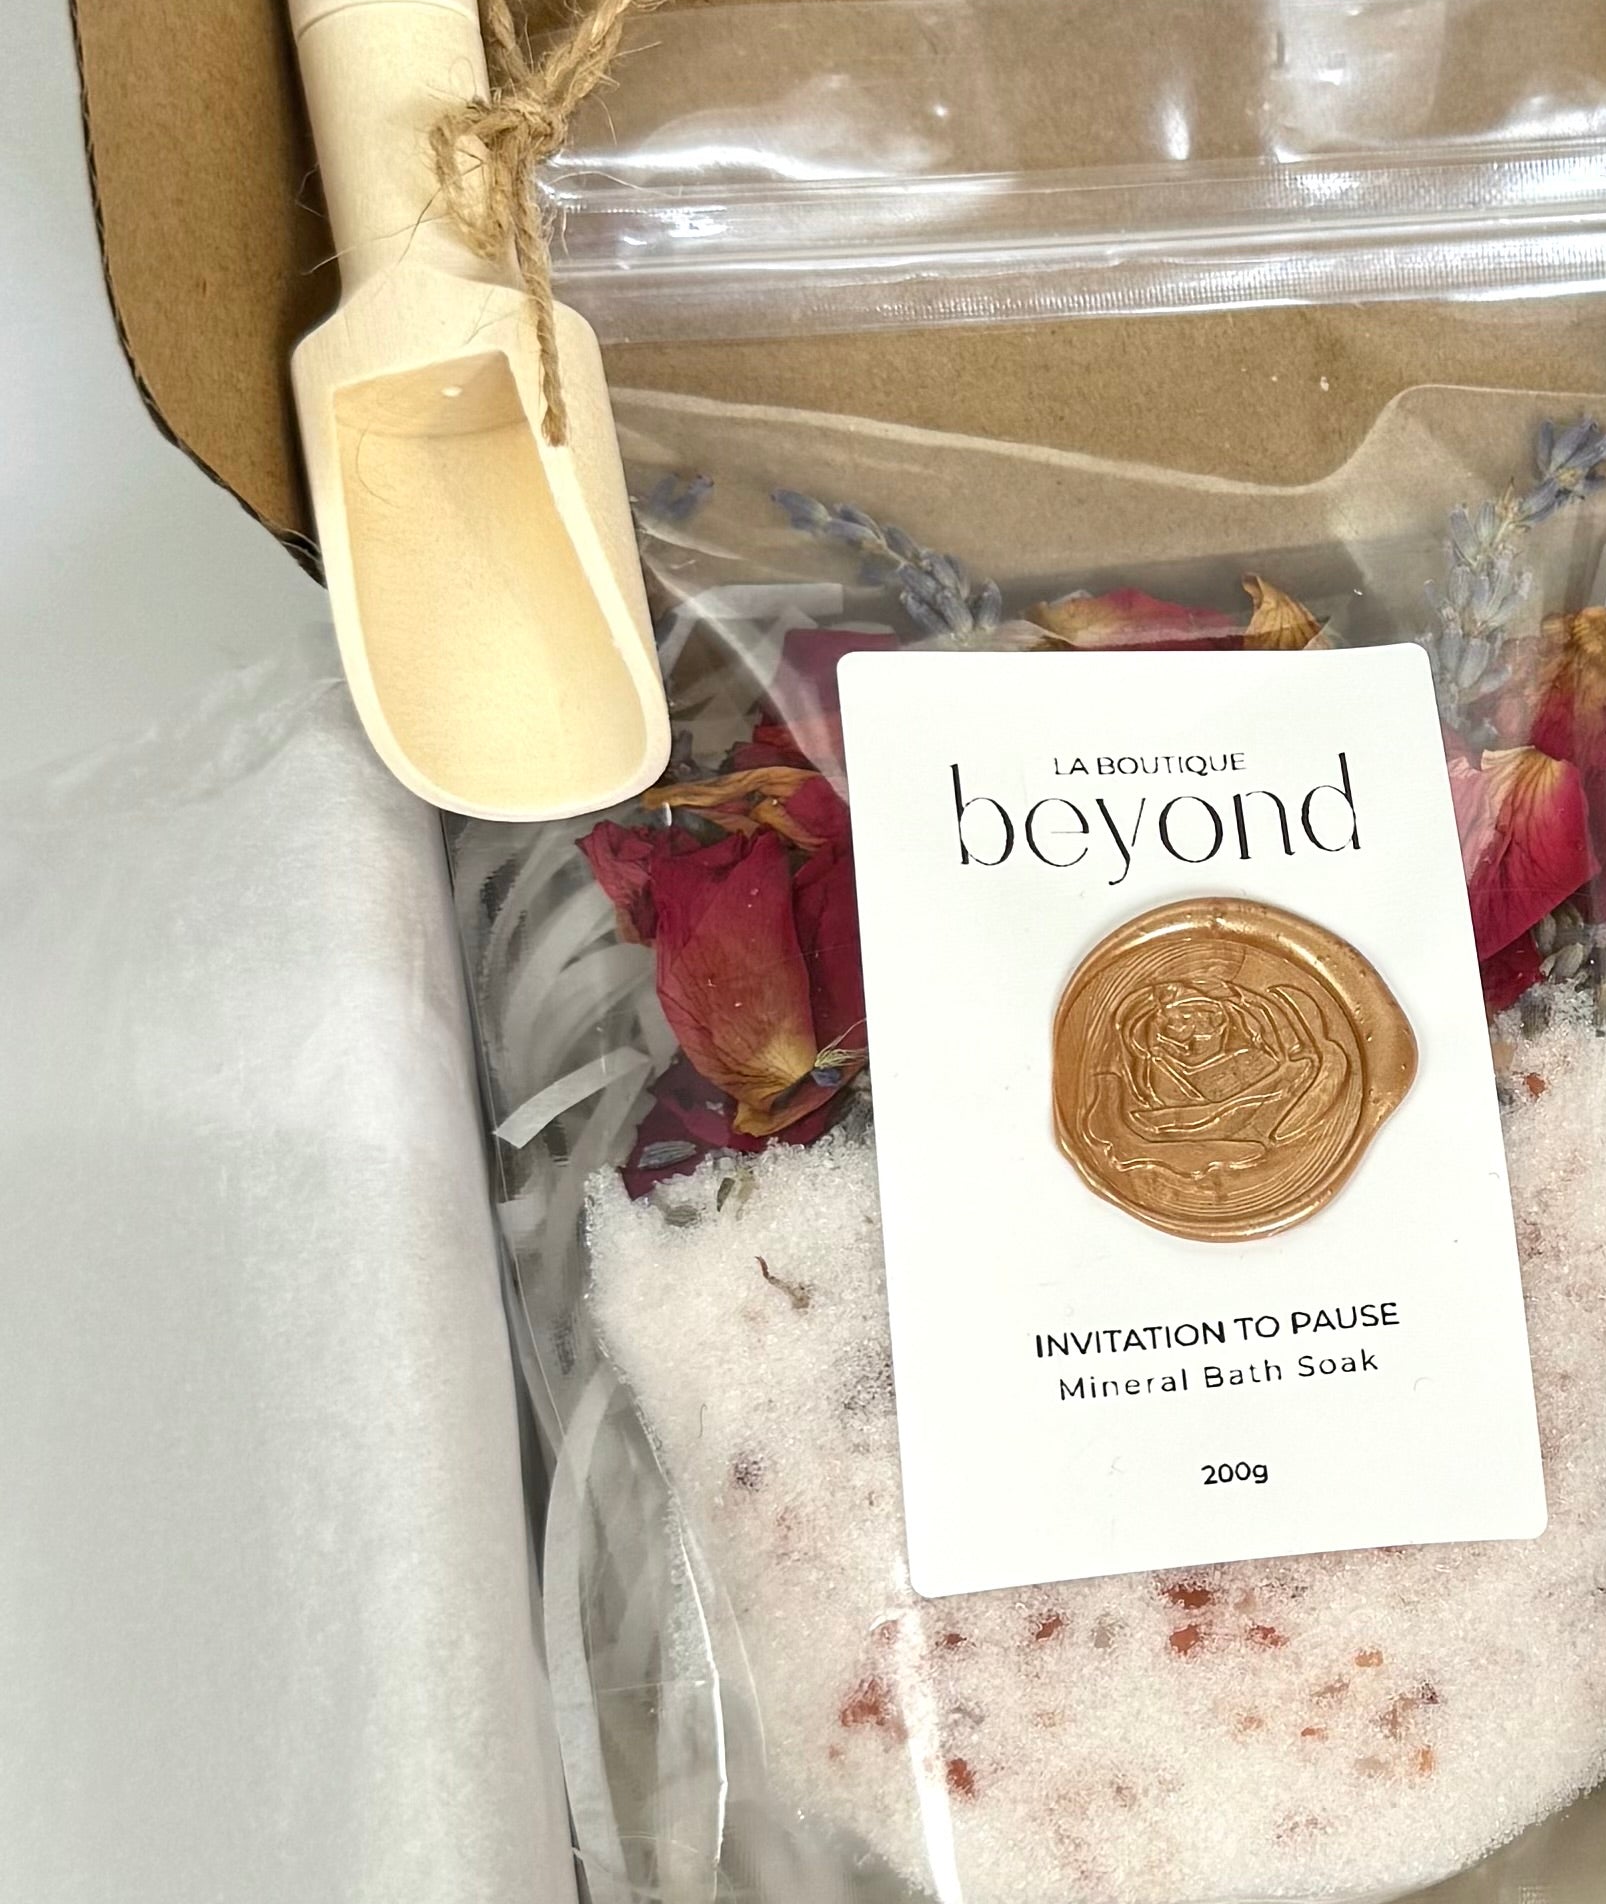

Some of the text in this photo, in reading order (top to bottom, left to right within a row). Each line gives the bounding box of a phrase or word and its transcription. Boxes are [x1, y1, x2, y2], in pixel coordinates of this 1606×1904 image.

[1054, 753, 1246, 776] LA BOUTIQUE
[950, 752, 1361, 886] beyond
[1036, 1302, 1400, 1358] INVITATION TO PAUSE
[1060, 1348, 1378, 1401] Mineral Bath Soak
[1201, 1461, 1268, 1485] 200g
